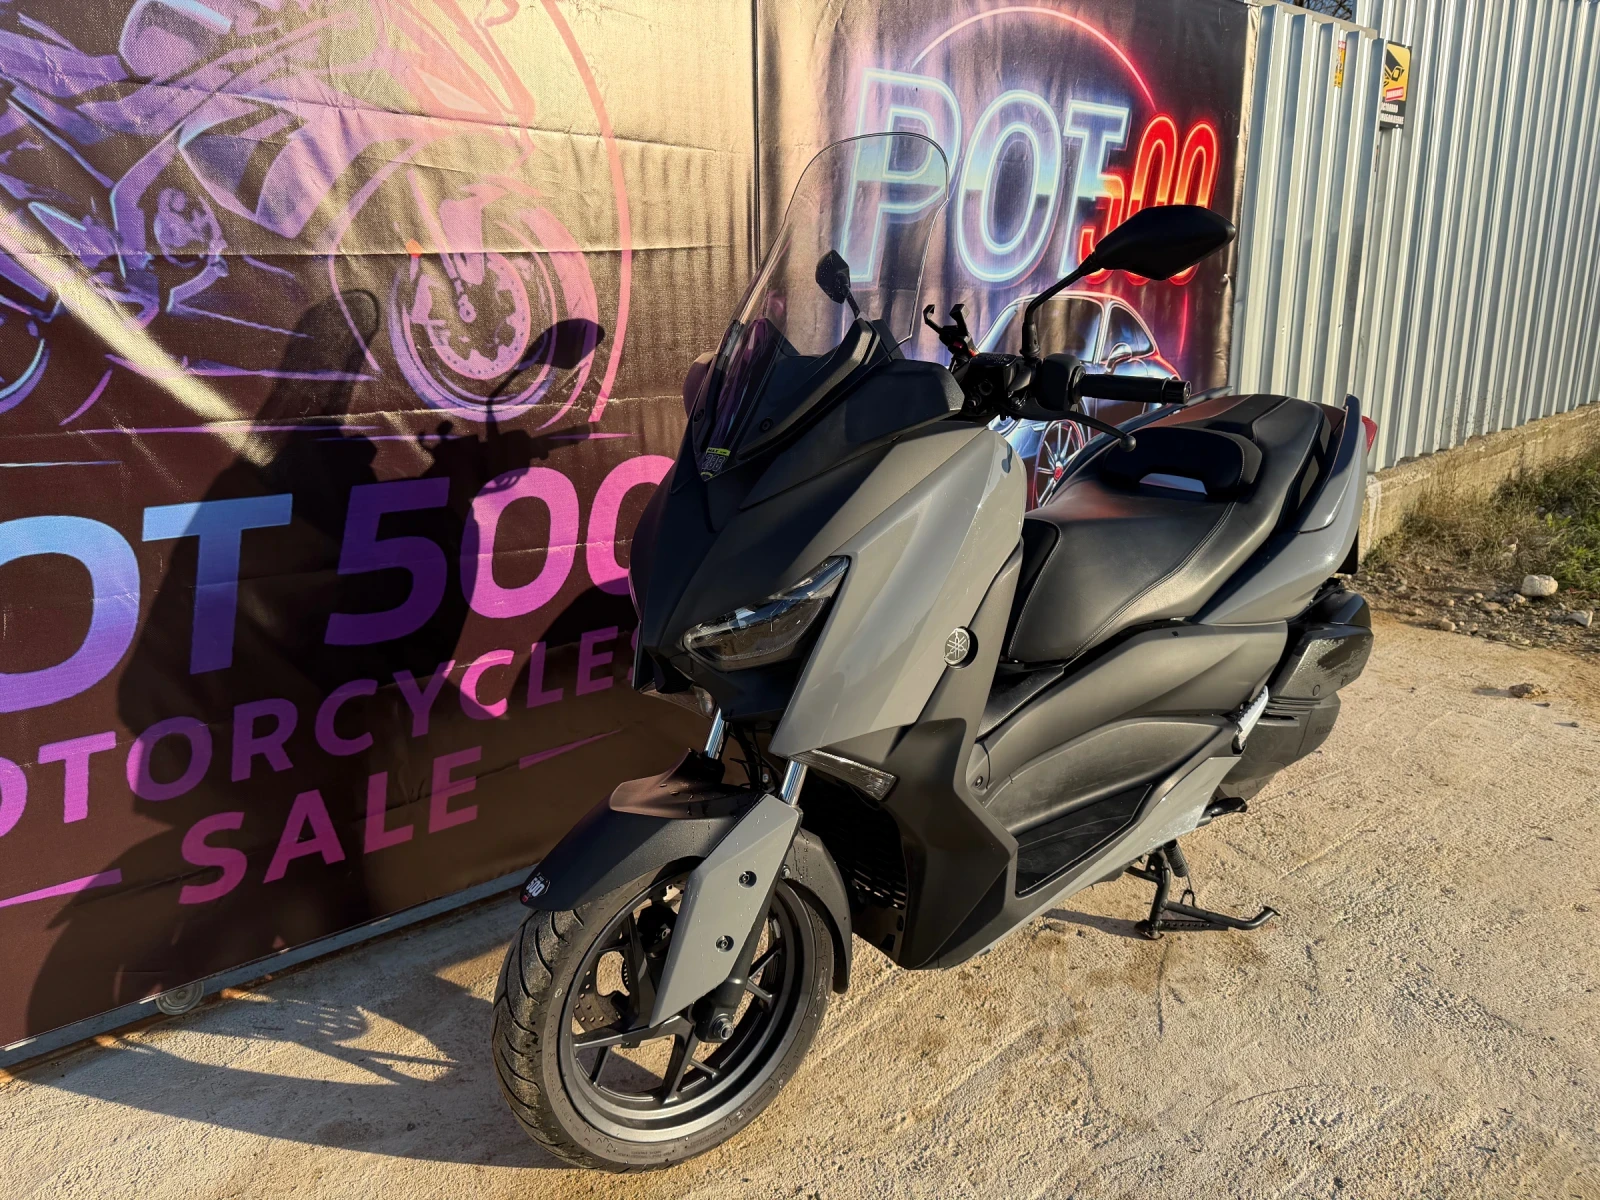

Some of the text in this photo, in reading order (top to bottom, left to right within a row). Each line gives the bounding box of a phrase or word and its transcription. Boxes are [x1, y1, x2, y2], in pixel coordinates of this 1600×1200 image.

[838, 67, 1130, 284] POT
[323, 454, 676, 646] 500
[0, 625, 638, 838] TORCYCLE
[178, 745, 483, 905] SALE
